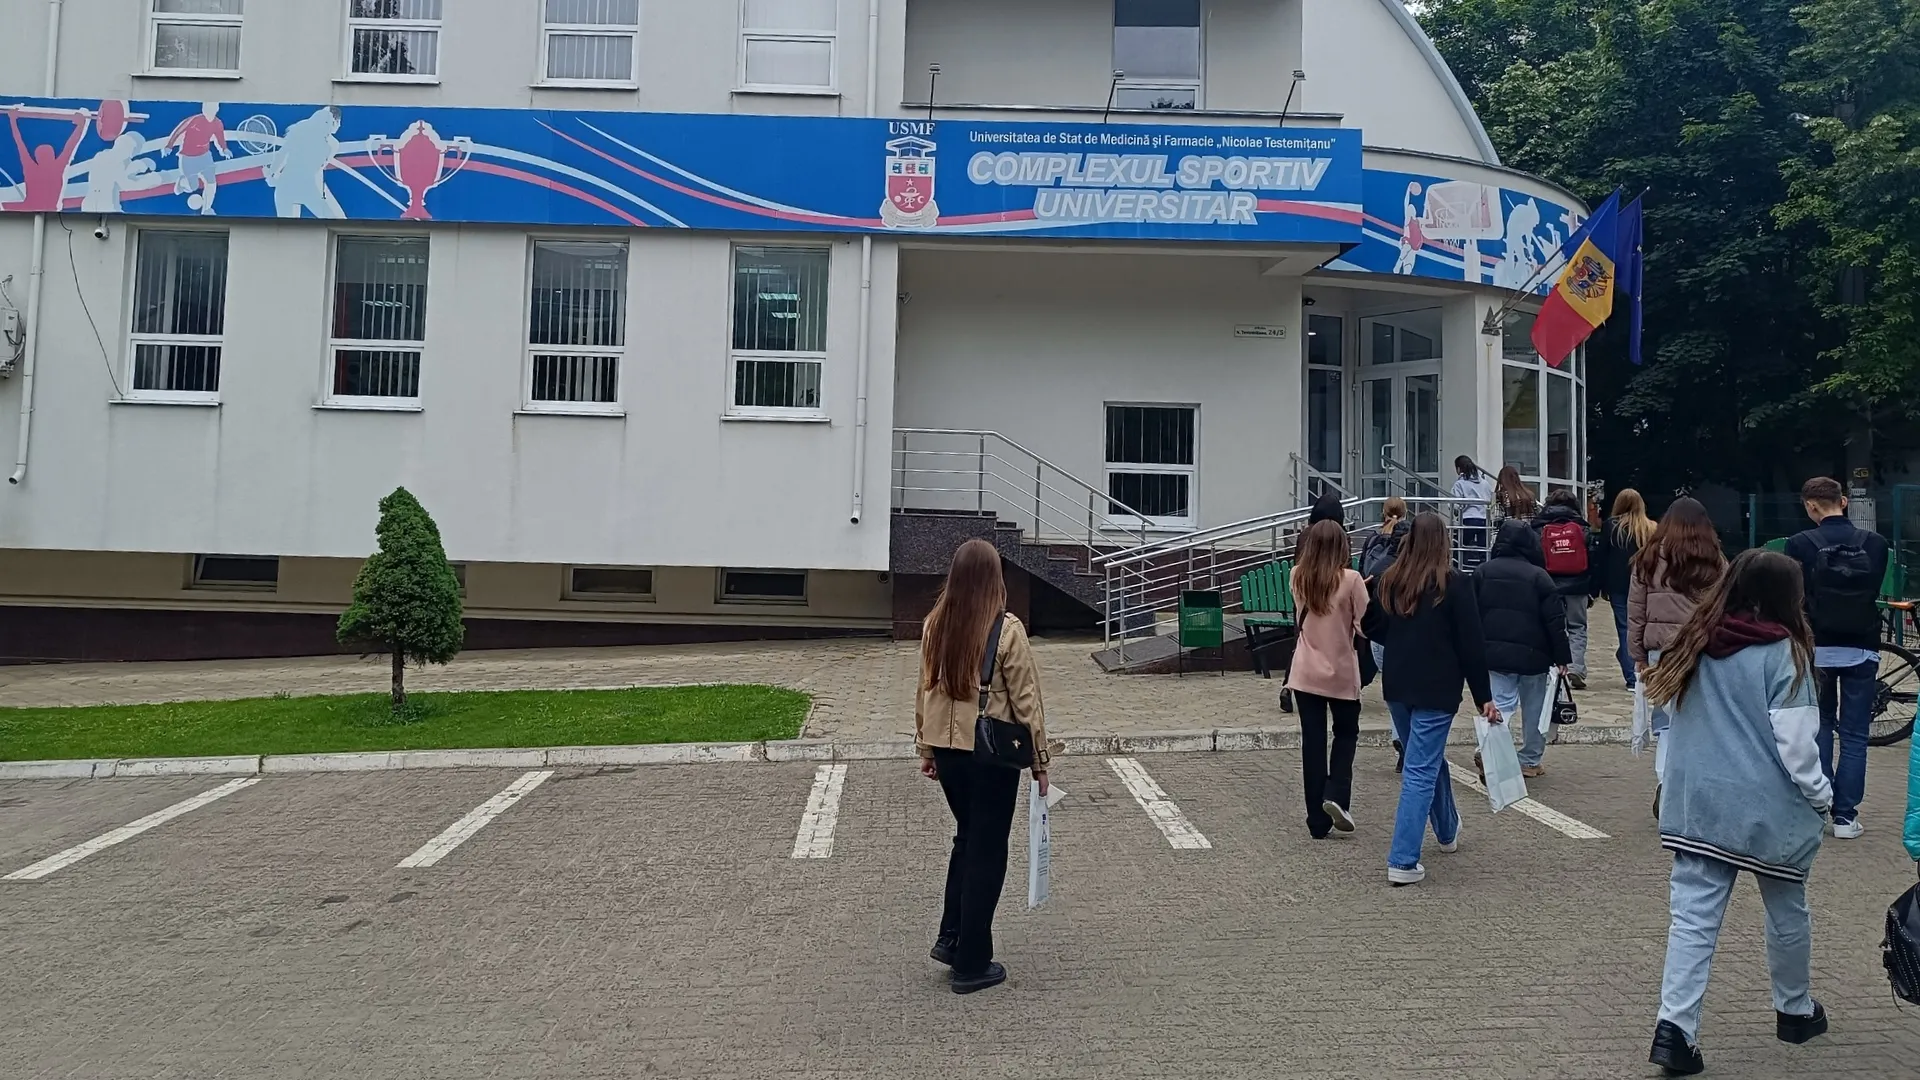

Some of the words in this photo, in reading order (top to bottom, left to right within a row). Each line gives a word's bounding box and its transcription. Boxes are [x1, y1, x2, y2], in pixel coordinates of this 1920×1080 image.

[888, 121, 936, 136] USMF
[969, 130, 1041, 144] Universitatea
[1043, 132, 1057, 144] de
[1059, 132, 1082, 145] Stat
[1084, 133, 1098, 145] de
[1100, 133, 1150, 146] Medicină
[1164, 134, 1214, 147] Farmacie
[970, 153, 1173, 186] COMPLEXUL
[1179, 157, 1326, 188] SPORTIV
[1036, 190, 1253, 222] UNIVERSITAR
